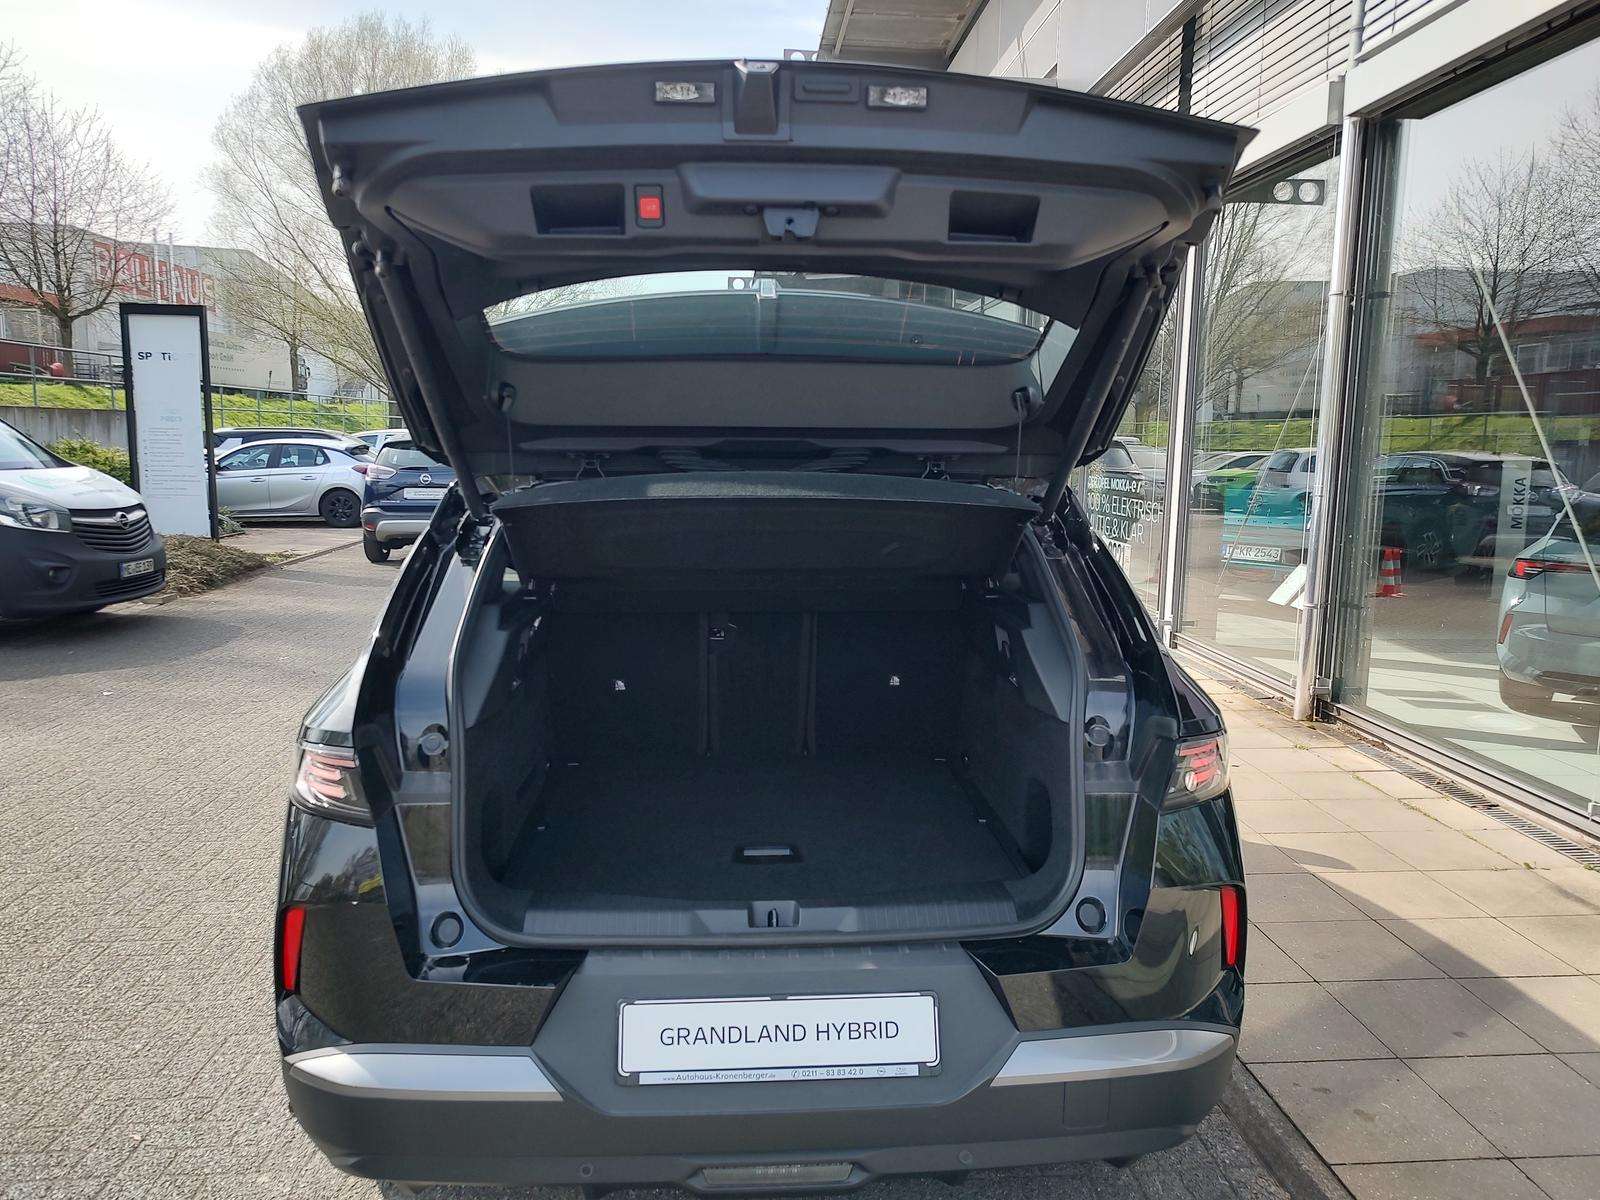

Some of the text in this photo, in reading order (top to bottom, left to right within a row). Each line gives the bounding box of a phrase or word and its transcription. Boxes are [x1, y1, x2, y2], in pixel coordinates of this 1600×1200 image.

[1510, 477, 1527, 529] MOKKA
[1112, 518, 1119, 538] &
[1254, 547, 1280, 559] 2543
[659, 1021, 900, 1046] GRANDLAND HYBRID
[801, 1069, 818, 1077] 0211
